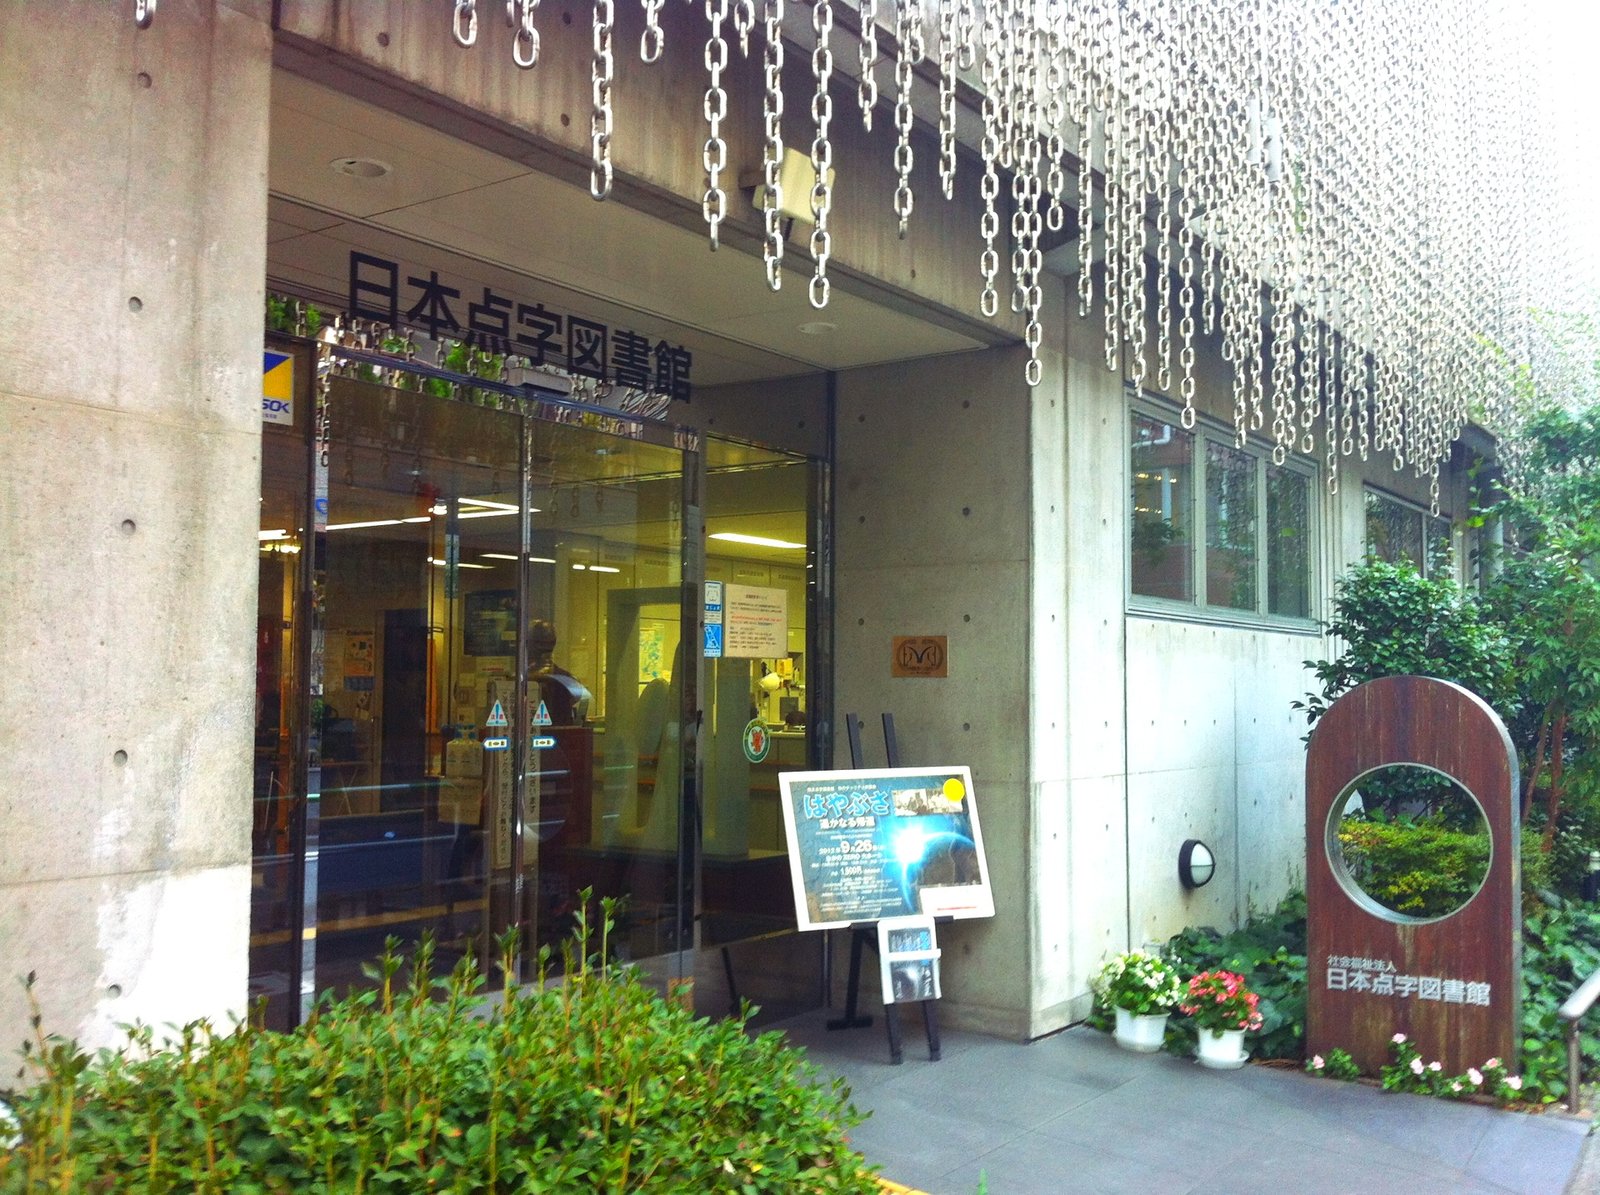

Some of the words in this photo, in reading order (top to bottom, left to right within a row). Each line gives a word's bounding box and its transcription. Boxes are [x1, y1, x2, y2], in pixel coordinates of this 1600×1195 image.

[349, 250, 693, 403] 日本点字図書館
[803, 791, 890, 819] はやぶさ
[1327, 954, 1397, 973] 社会福祉法人
[1326, 968, 1491, 1007] 日本点字図書館
